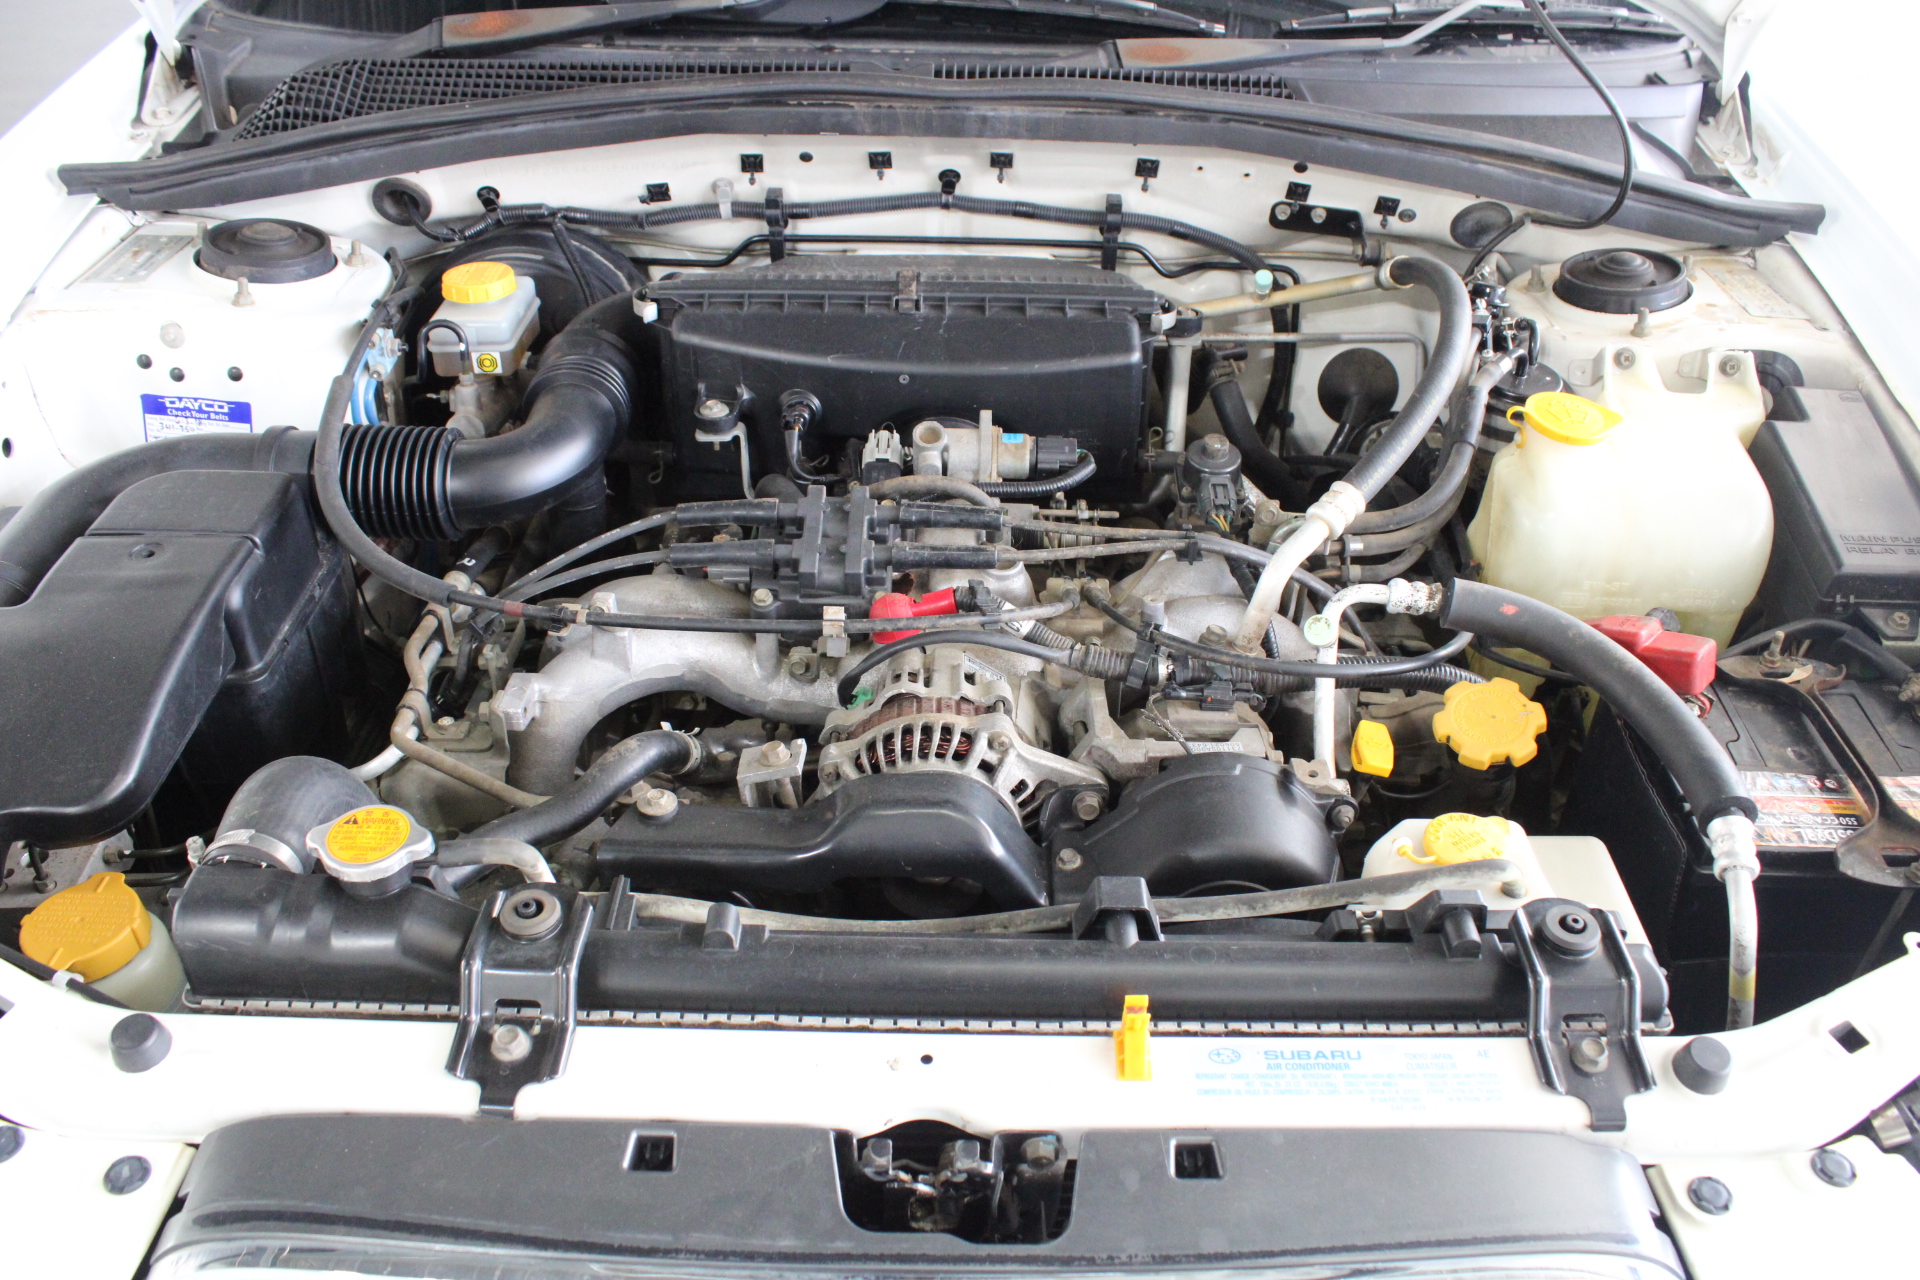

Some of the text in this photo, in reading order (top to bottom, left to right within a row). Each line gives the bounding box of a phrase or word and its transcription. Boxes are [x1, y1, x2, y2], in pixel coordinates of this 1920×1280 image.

[162, 397, 230, 412] DAYCO
[167, 408, 229, 421] Check Your Belts
[1840, 534, 1887, 543] MAIN
[1846, 546, 1899, 555] RELAY
[361, 817, 400, 826] WARNING
[1263, 1050, 1362, 1061] SUBARU
[1429, 1053, 1454, 1061] JAPAN
[1476, 1050, 1491, 1059] AE
[1266, 1062, 1458, 1071] AIR CONDITIONER CLIMATISEUR
